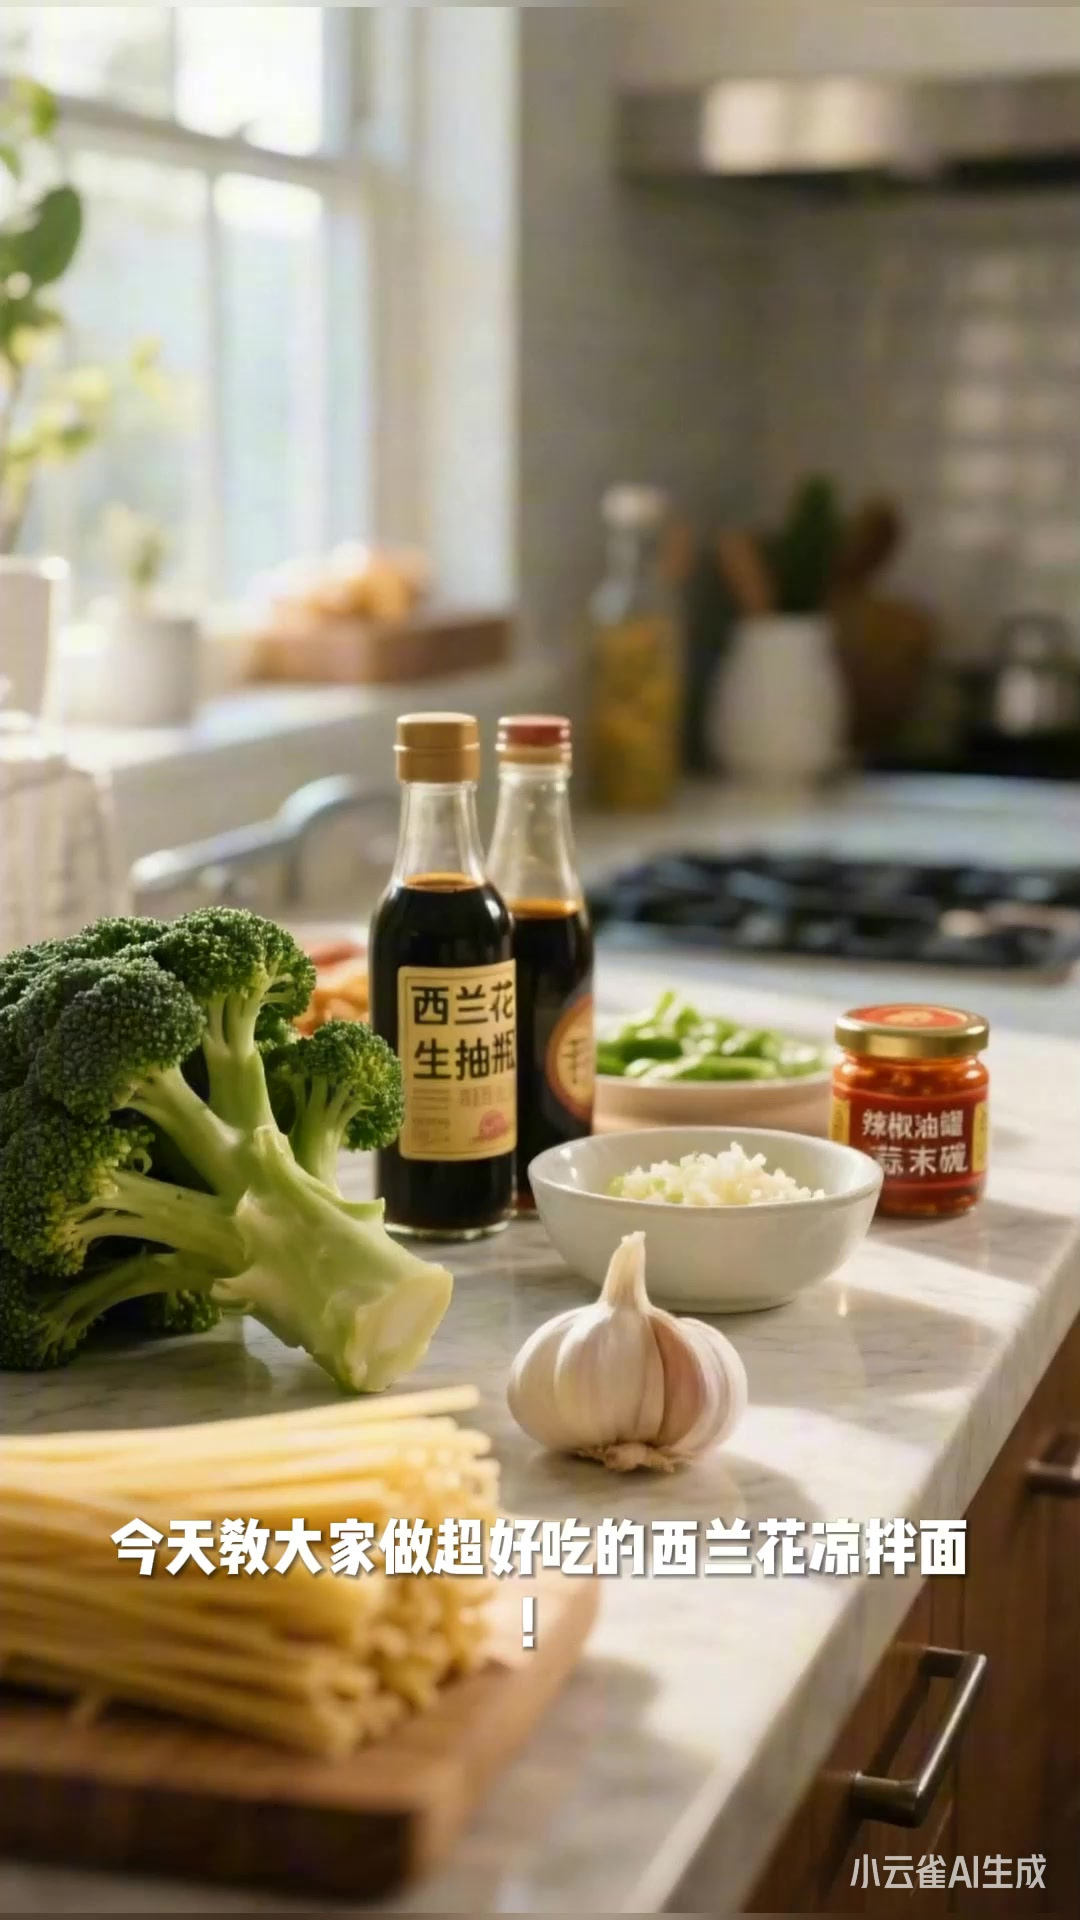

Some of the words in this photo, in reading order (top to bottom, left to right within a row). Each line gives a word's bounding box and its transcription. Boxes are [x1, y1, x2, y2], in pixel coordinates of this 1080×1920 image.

[411, 980, 514, 1026] 西兰花
[862, 1108, 964, 1139] 辣椒油罐
